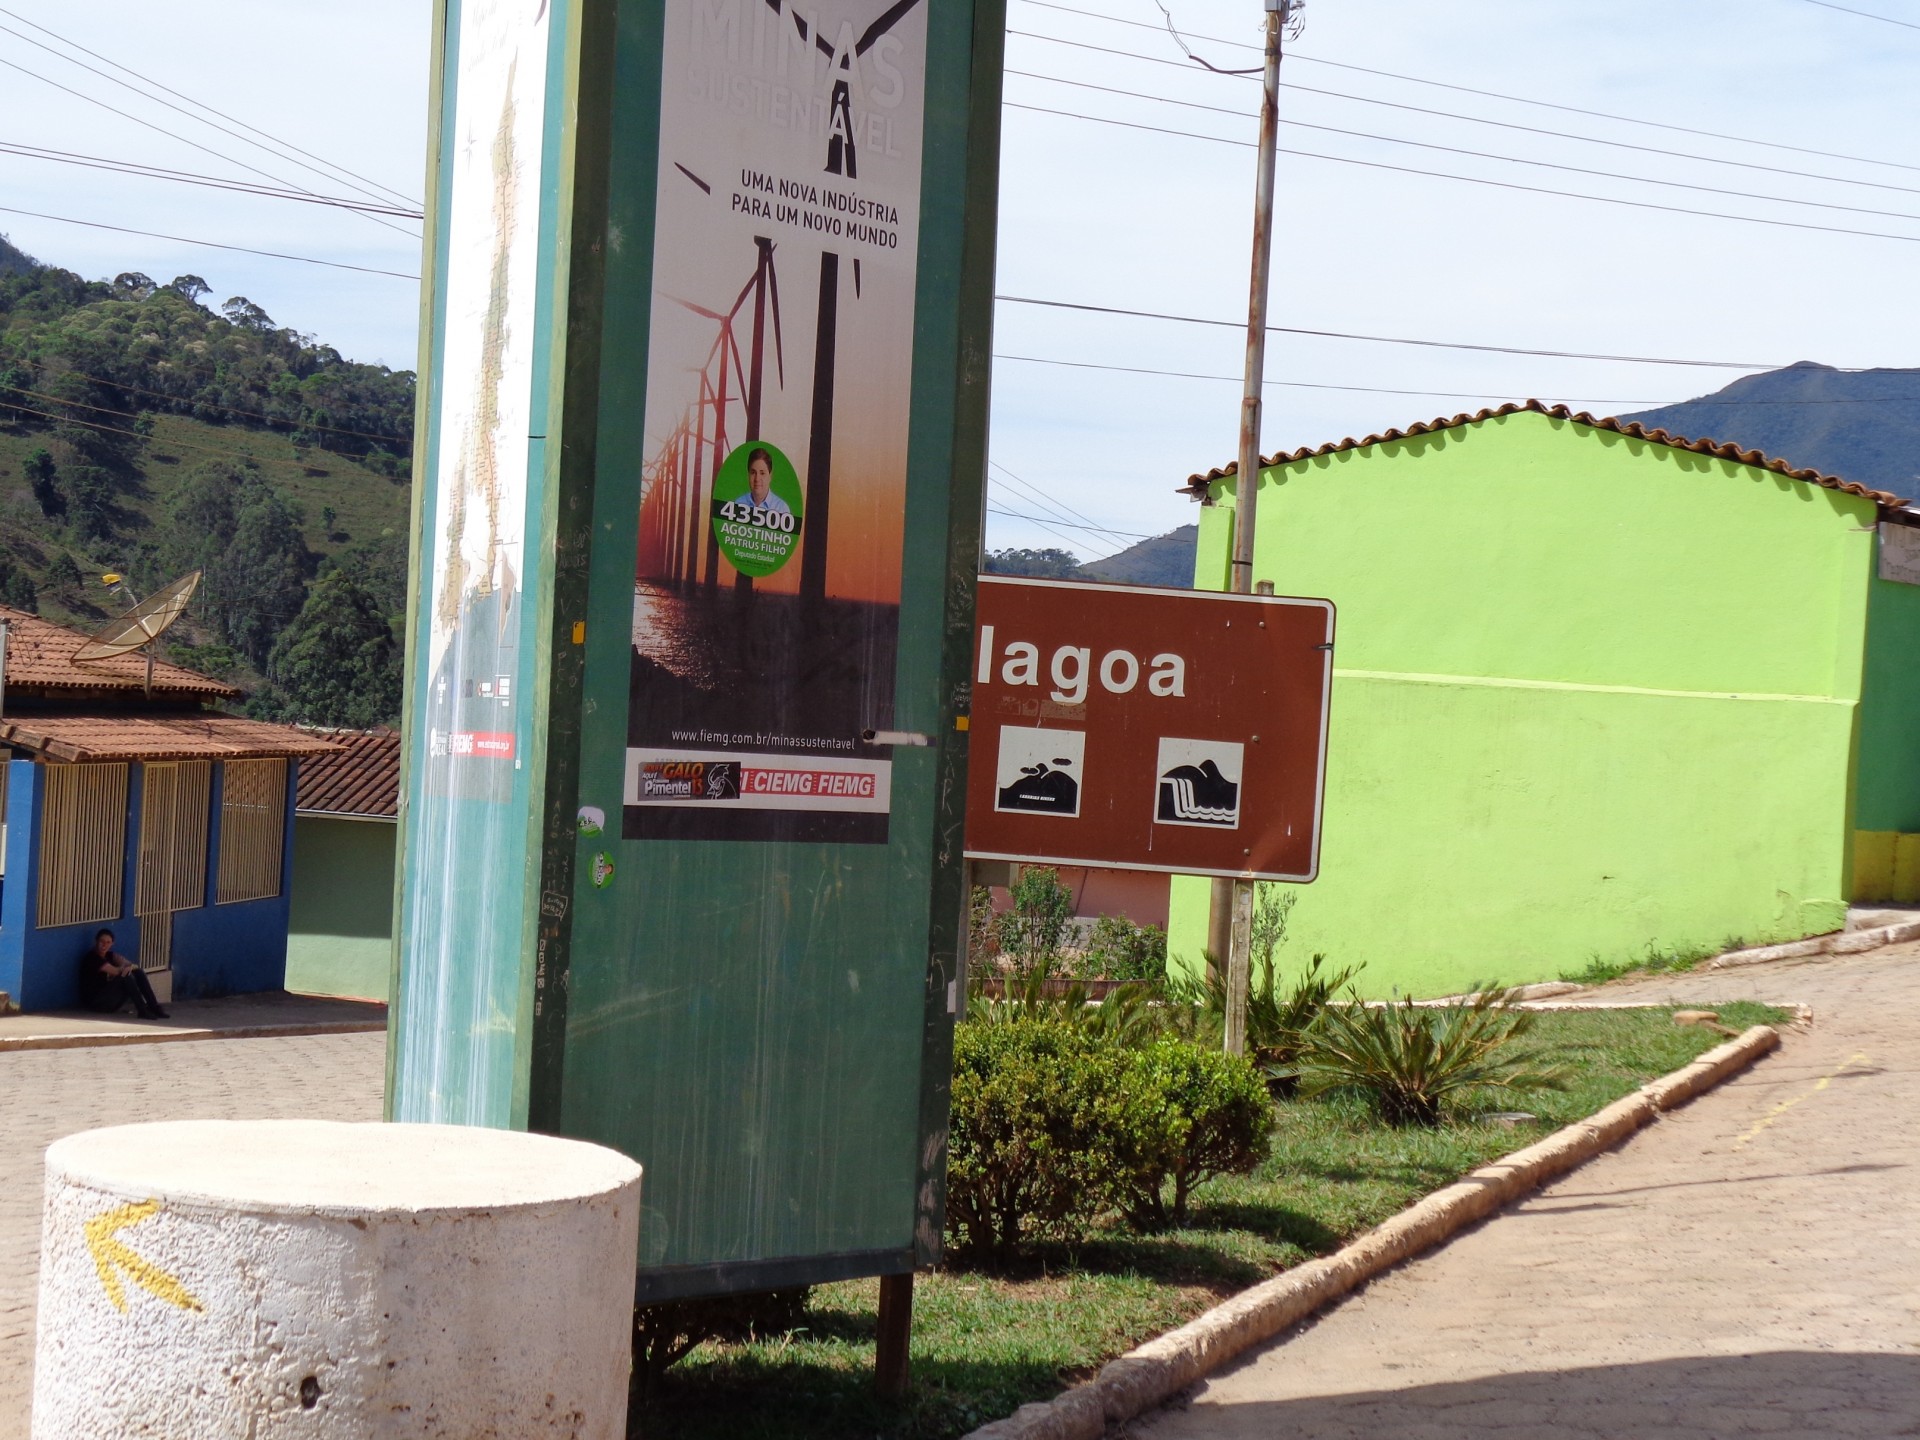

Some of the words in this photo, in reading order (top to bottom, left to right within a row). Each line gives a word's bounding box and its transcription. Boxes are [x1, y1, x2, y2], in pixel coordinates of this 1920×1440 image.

[741, 169, 774, 194] UMA
[779, 178, 818, 205] NOVA
[822, 190, 899, 225] INDÚSTRIA
[732, 193, 771, 219] PARA
[776, 203, 798, 226] UM
[803, 211, 842, 235] NOVO
[846, 221, 898, 249] MUNDO
[720, 501, 795, 533] 43500
[720, 522, 792, 546] AGOSTINHO
[724, 535, 759, 551] PATRUS
[761, 543, 786, 556] FILHO
[977, 625, 1186, 705] lagoa
[671, 729, 855, 750] www.fiemg.com.br/minassustentavel
[663, 762, 704, 779] GALO
[644, 780, 692, 795] Pimentel
[753, 771, 813, 793] CIEMG
[818, 774, 872, 796] FIEMG
